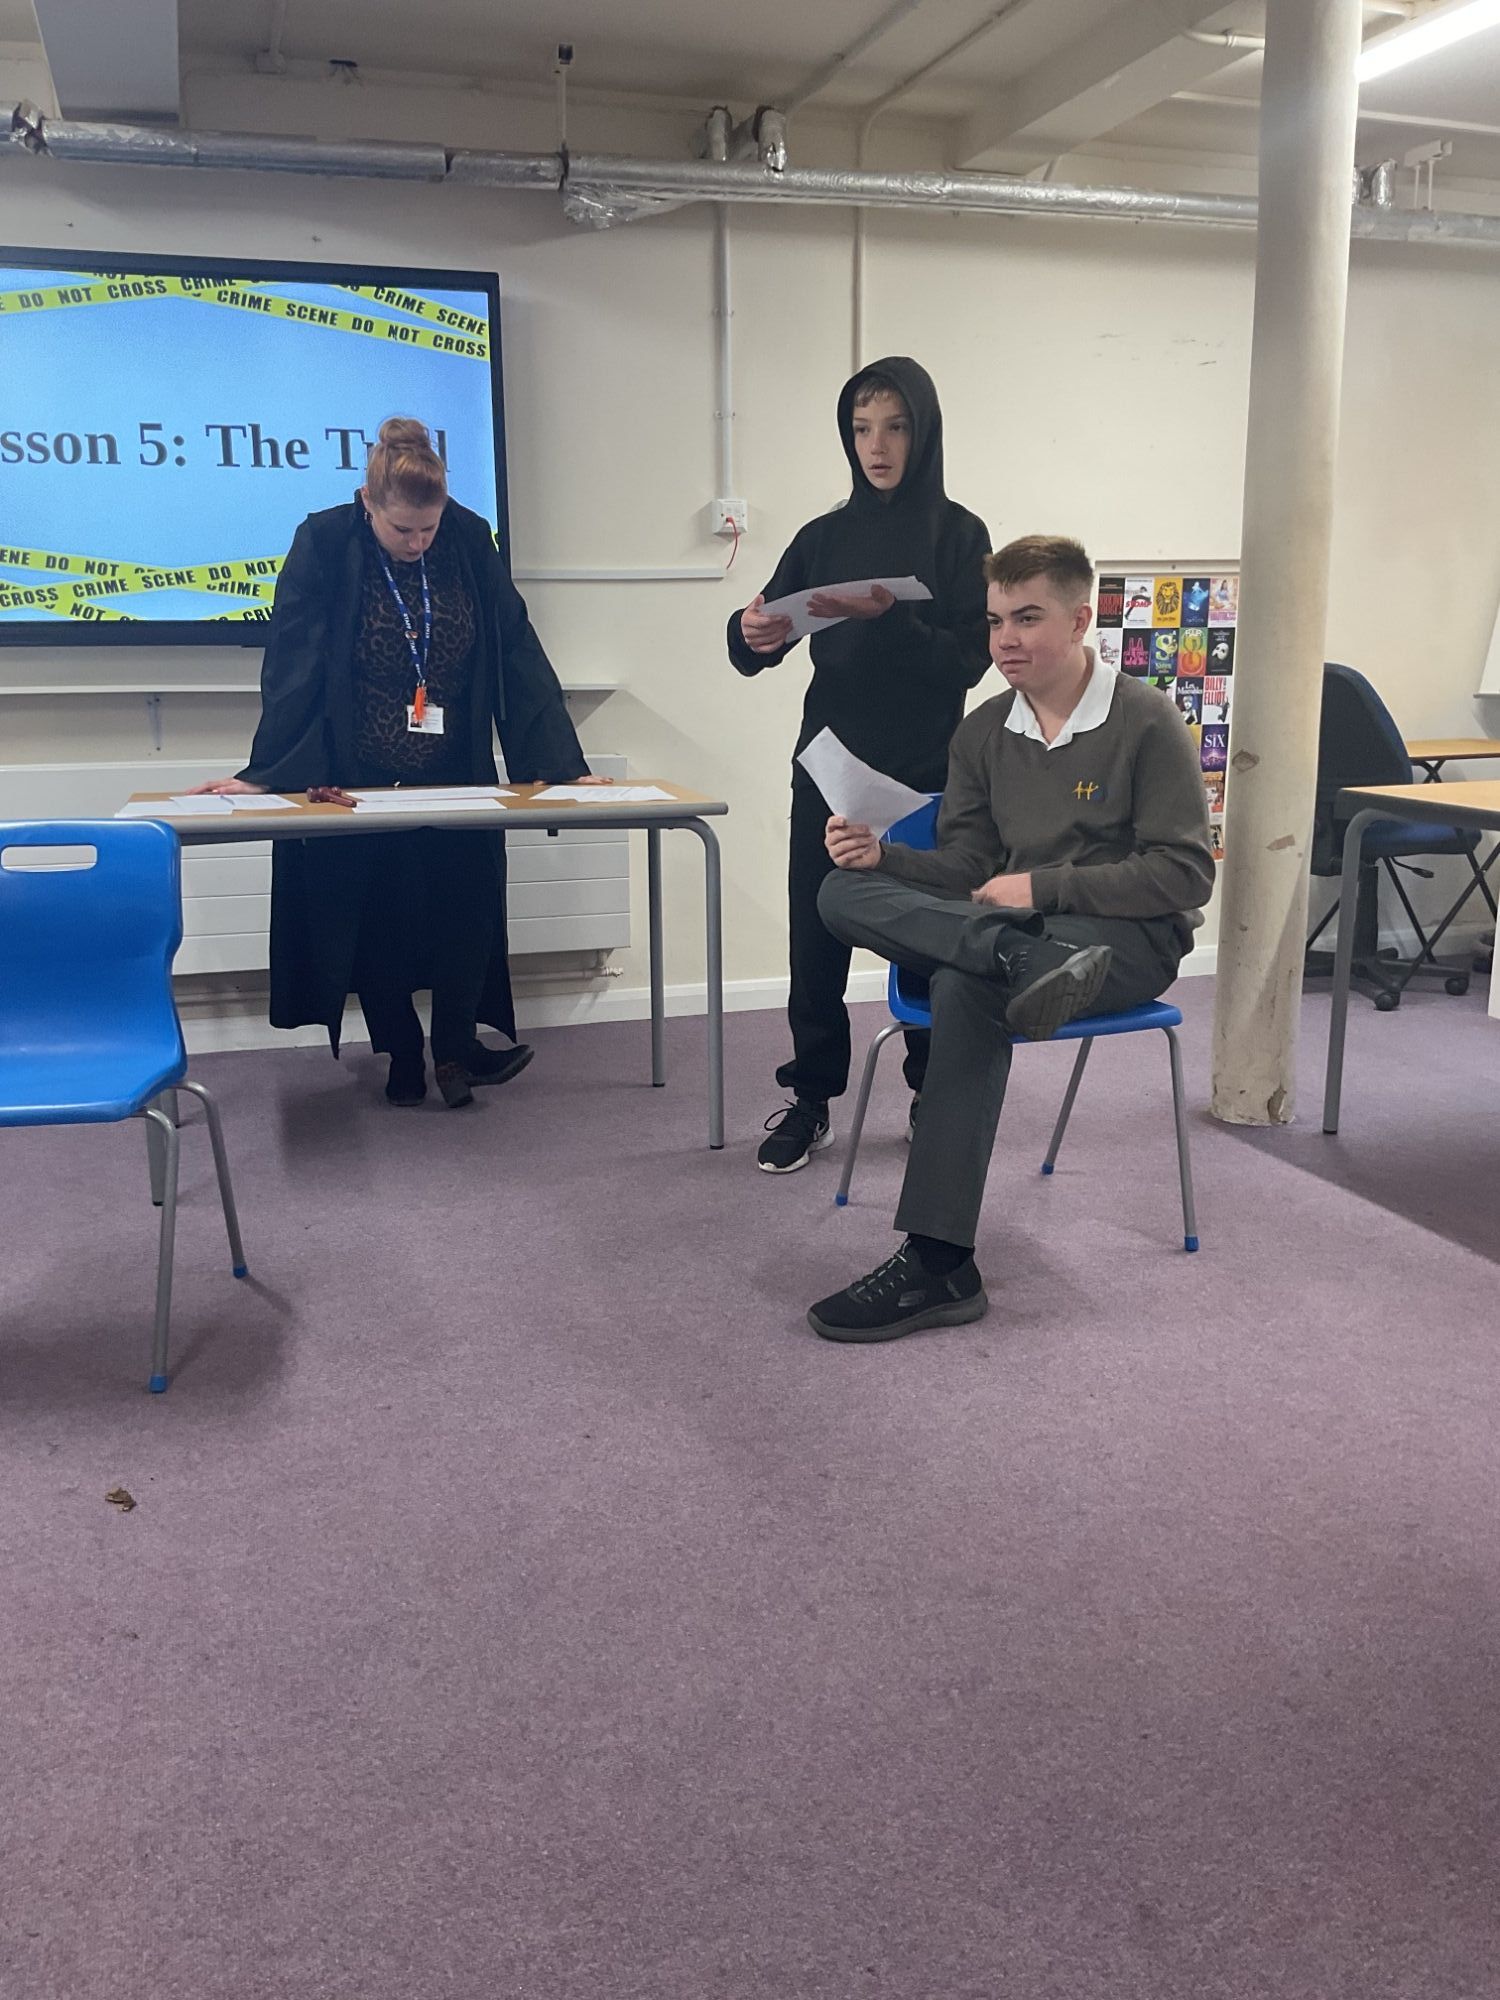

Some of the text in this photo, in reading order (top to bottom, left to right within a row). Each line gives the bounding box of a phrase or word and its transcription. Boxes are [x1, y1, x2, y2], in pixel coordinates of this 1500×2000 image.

[18, 292, 44, 309] DO
[57, 287, 93, 304] NOT
[107, 279, 167, 299] CROSS
[217, 289, 487, 357] CRIME SCENE DO NOT CROSS
[373, 286, 486, 336] CRIME SCENE
[0, 431, 121, 464] sson
[139, 422, 186, 467] 5:
[205, 423, 310, 469] The
[0, 548, 119, 577] ENE DO NOT
[0, 587, 59, 607] CROSS
[72, 578, 129, 598] CRIME
[141, 570, 196, 589] SCENE
[208, 565, 231, 580] DO
[244, 560, 277, 576] NOT
[70, 602, 106, 621] NOT
[1125, 600, 1152, 608] STOMP
[403, 613, 412, 630] STAFF
[1204, 677, 1223, 691] BILLY
